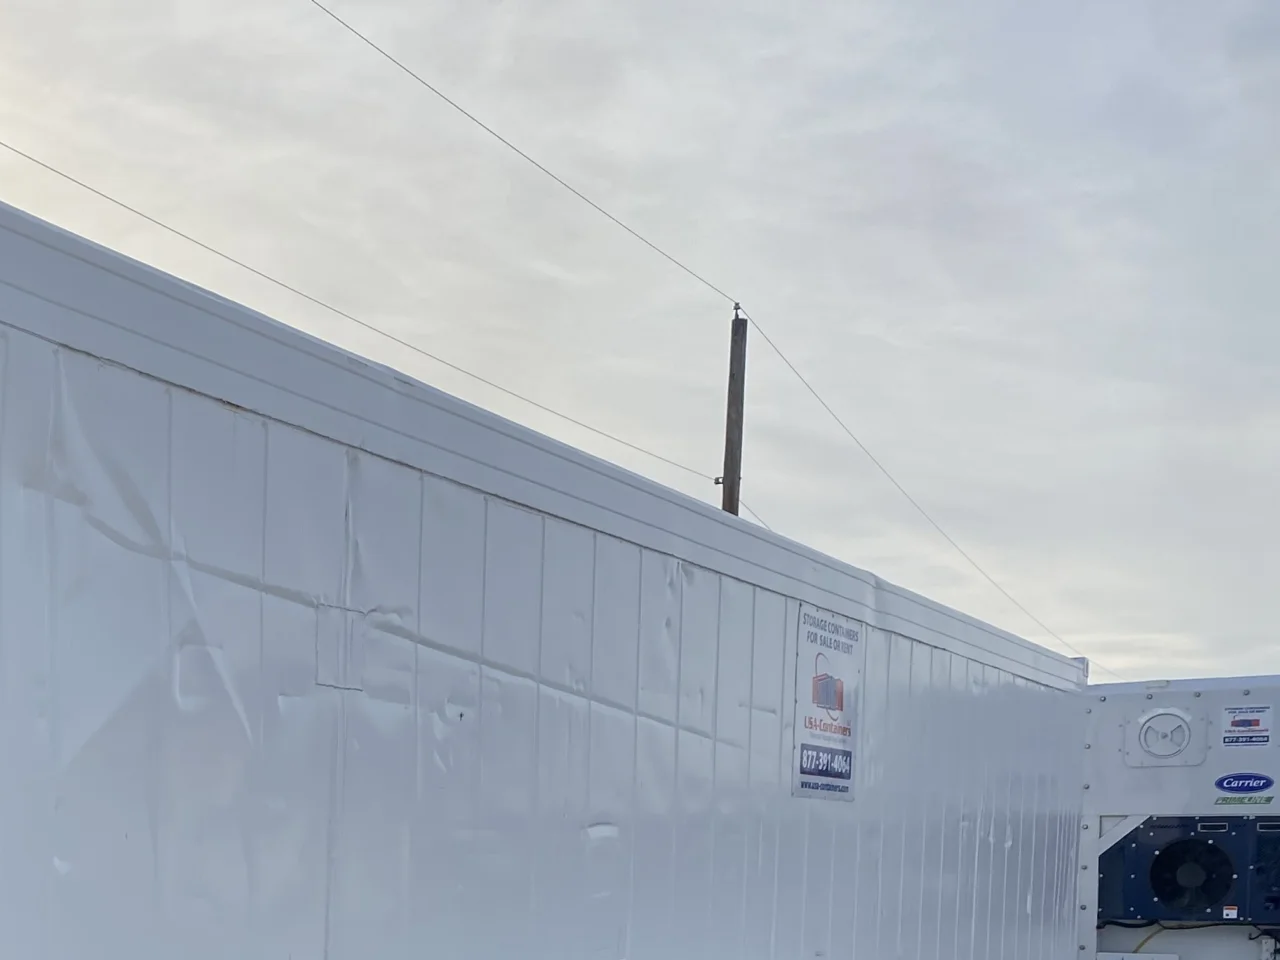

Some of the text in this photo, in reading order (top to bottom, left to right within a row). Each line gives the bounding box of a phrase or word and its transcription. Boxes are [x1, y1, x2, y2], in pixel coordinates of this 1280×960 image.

[803, 612, 859, 642] STORAGE CONTAINERS
[807, 630, 853, 655] FOR SALE OR RENT
[802, 749, 850, 773] 877-391-4064
[1223, 778, 1266, 788] Carrier
